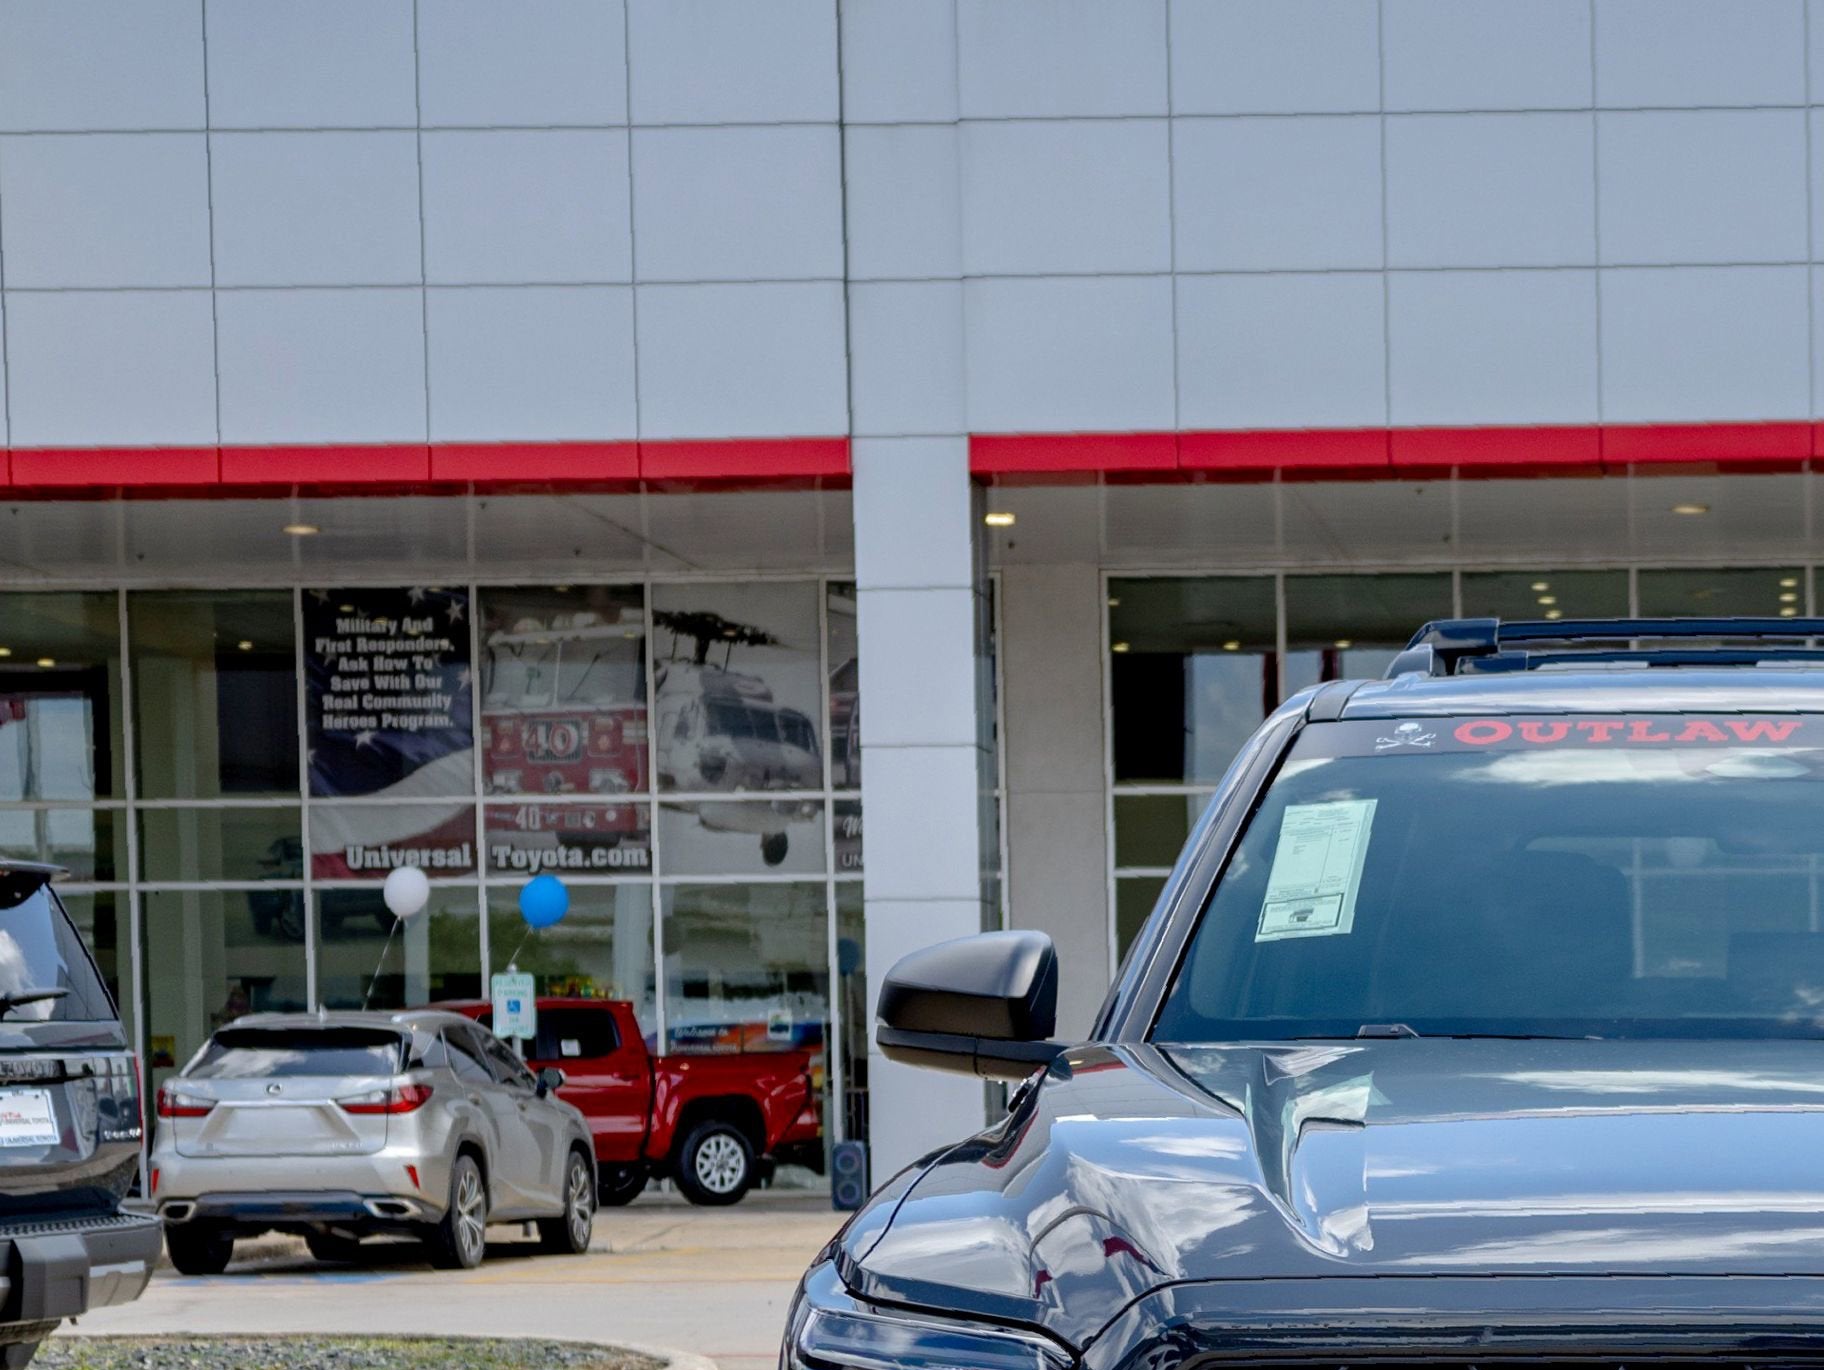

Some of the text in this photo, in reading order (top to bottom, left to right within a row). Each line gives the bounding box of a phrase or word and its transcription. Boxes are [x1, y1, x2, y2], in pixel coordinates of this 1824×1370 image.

[336, 617, 433, 635] Military And
[315, 638, 352, 653] First
[338, 655, 433, 671] Ask How To
[330, 674, 443, 691] Save With Our
[322, 693, 451, 710] Real Community
[322, 713, 454, 731] Heroes Program.
[524, 719, 578, 755] 40
[1453, 719, 1801, 745] OUTLAW
[515, 805, 542, 829] 40
[346, 843, 649, 873] Universal Toyota.com
